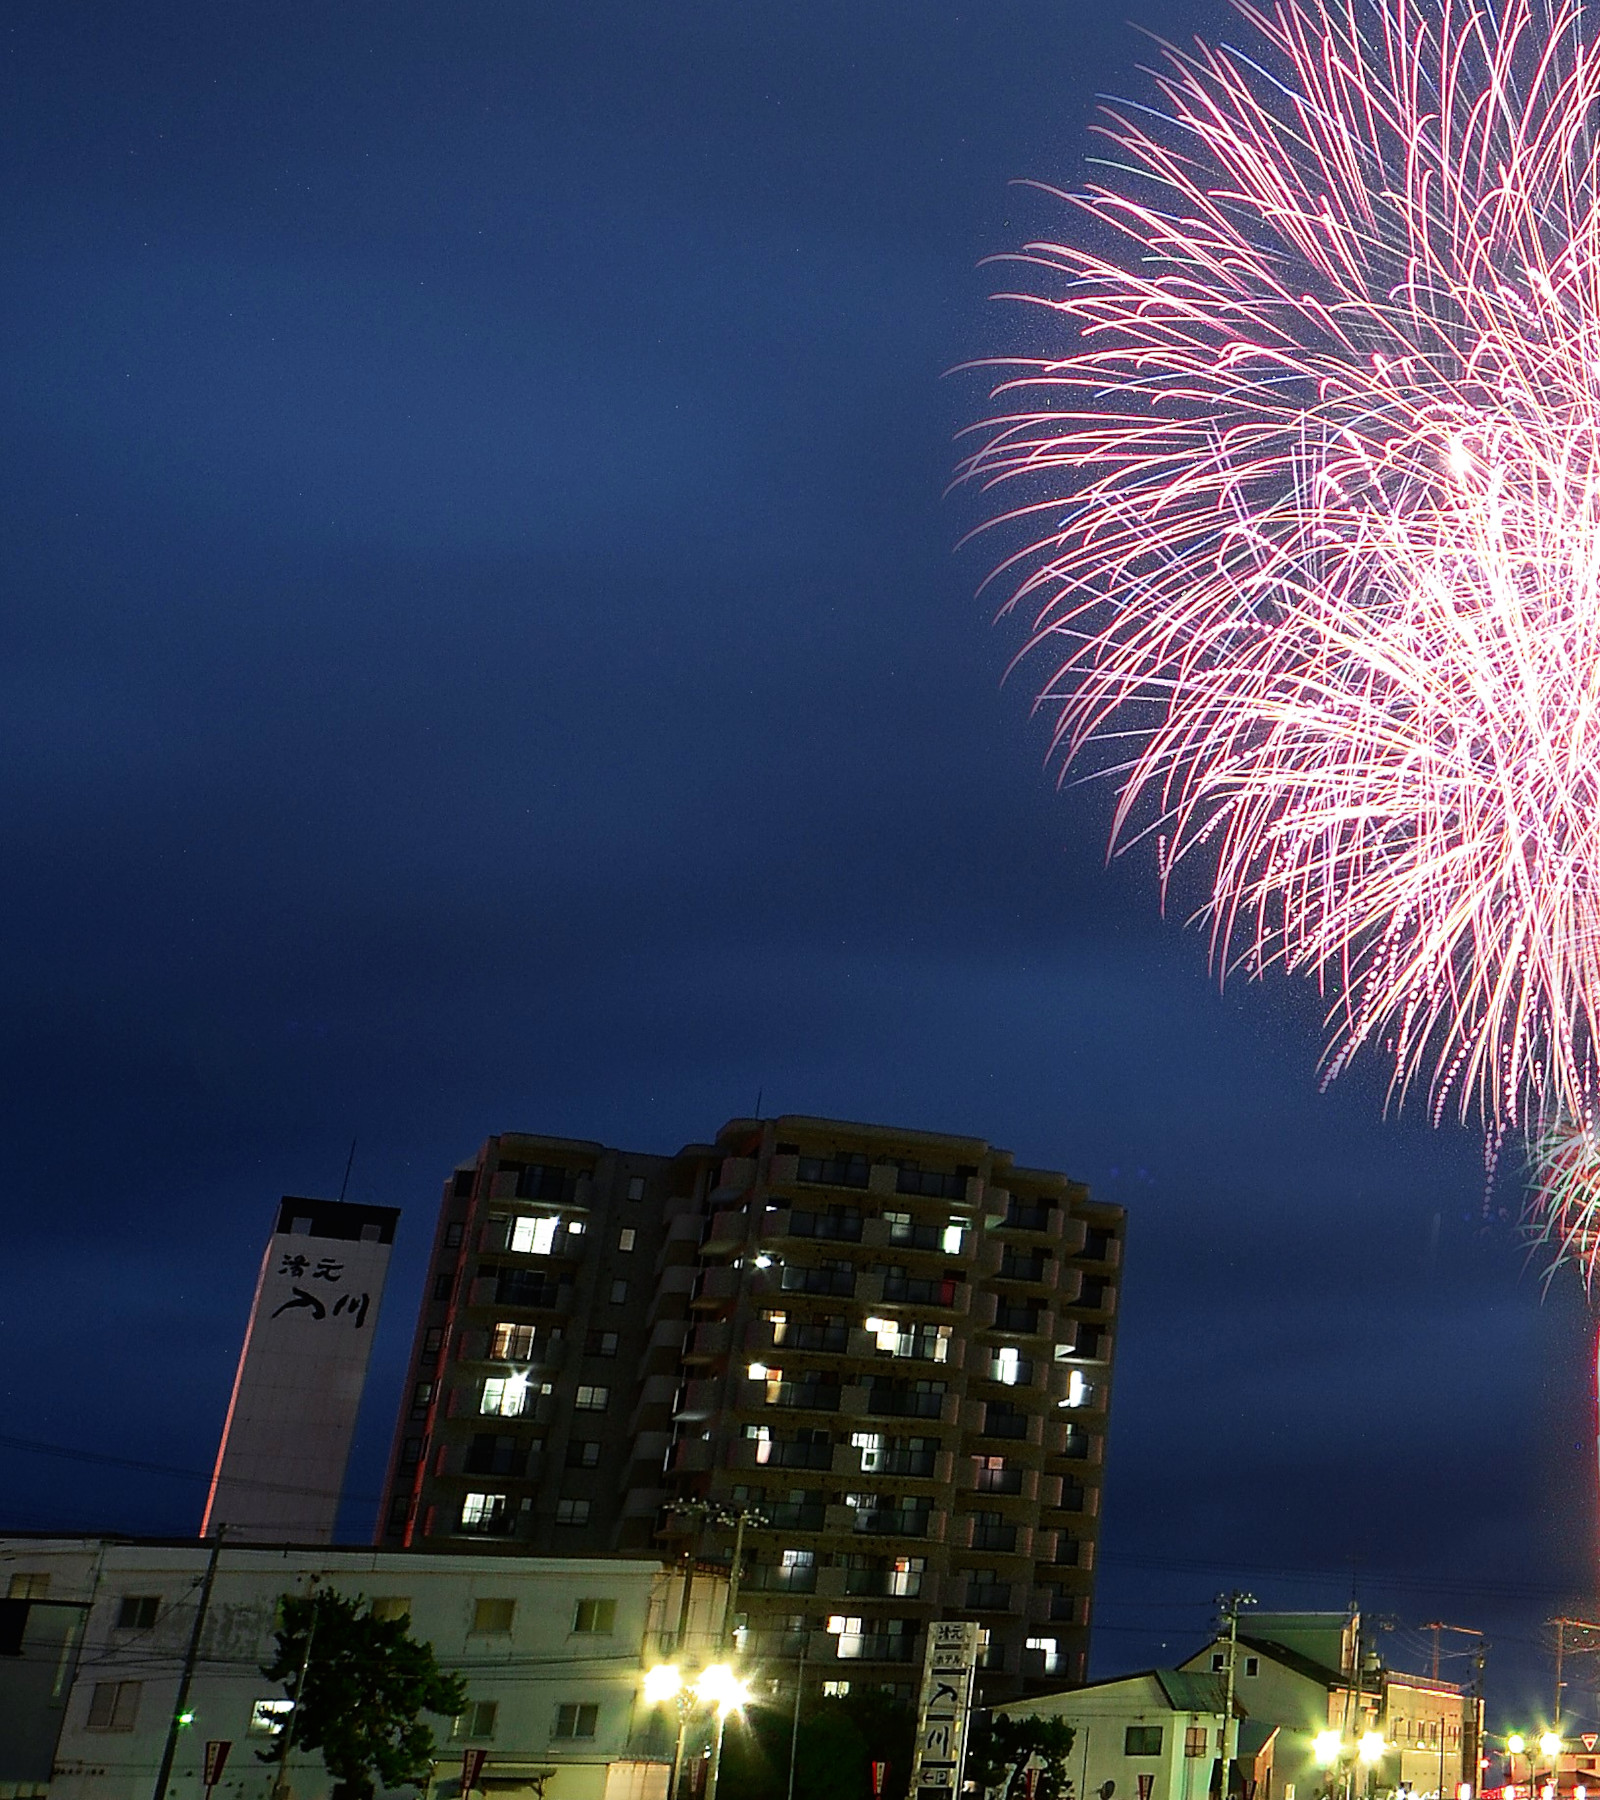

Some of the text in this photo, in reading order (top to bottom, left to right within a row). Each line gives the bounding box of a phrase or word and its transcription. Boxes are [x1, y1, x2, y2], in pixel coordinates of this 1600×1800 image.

[271, 1287, 369, 1328] 入川
[936, 1654, 961, 1665] ホテル
[927, 1682, 958, 1757] 入川
